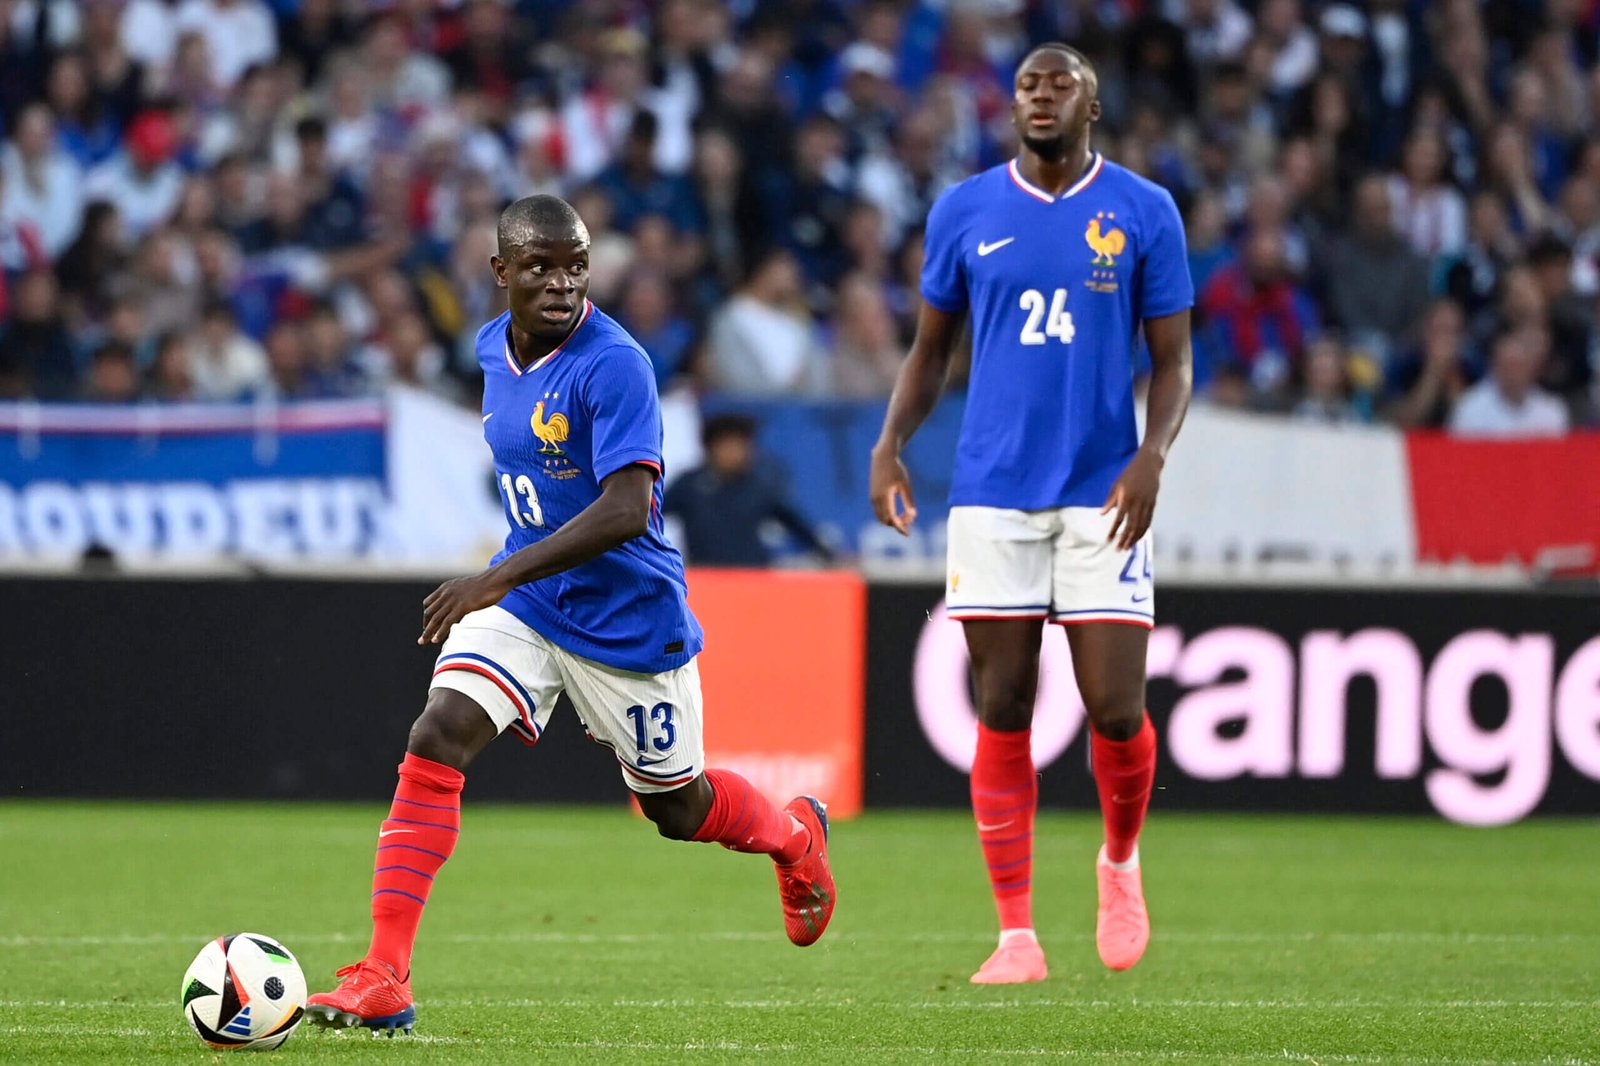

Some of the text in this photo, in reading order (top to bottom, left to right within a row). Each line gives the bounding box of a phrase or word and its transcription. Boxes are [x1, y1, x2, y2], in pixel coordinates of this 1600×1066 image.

[1019, 288, 1075, 345] 24
[501, 473, 545, 528] 13
[627, 702, 676, 753] 13
